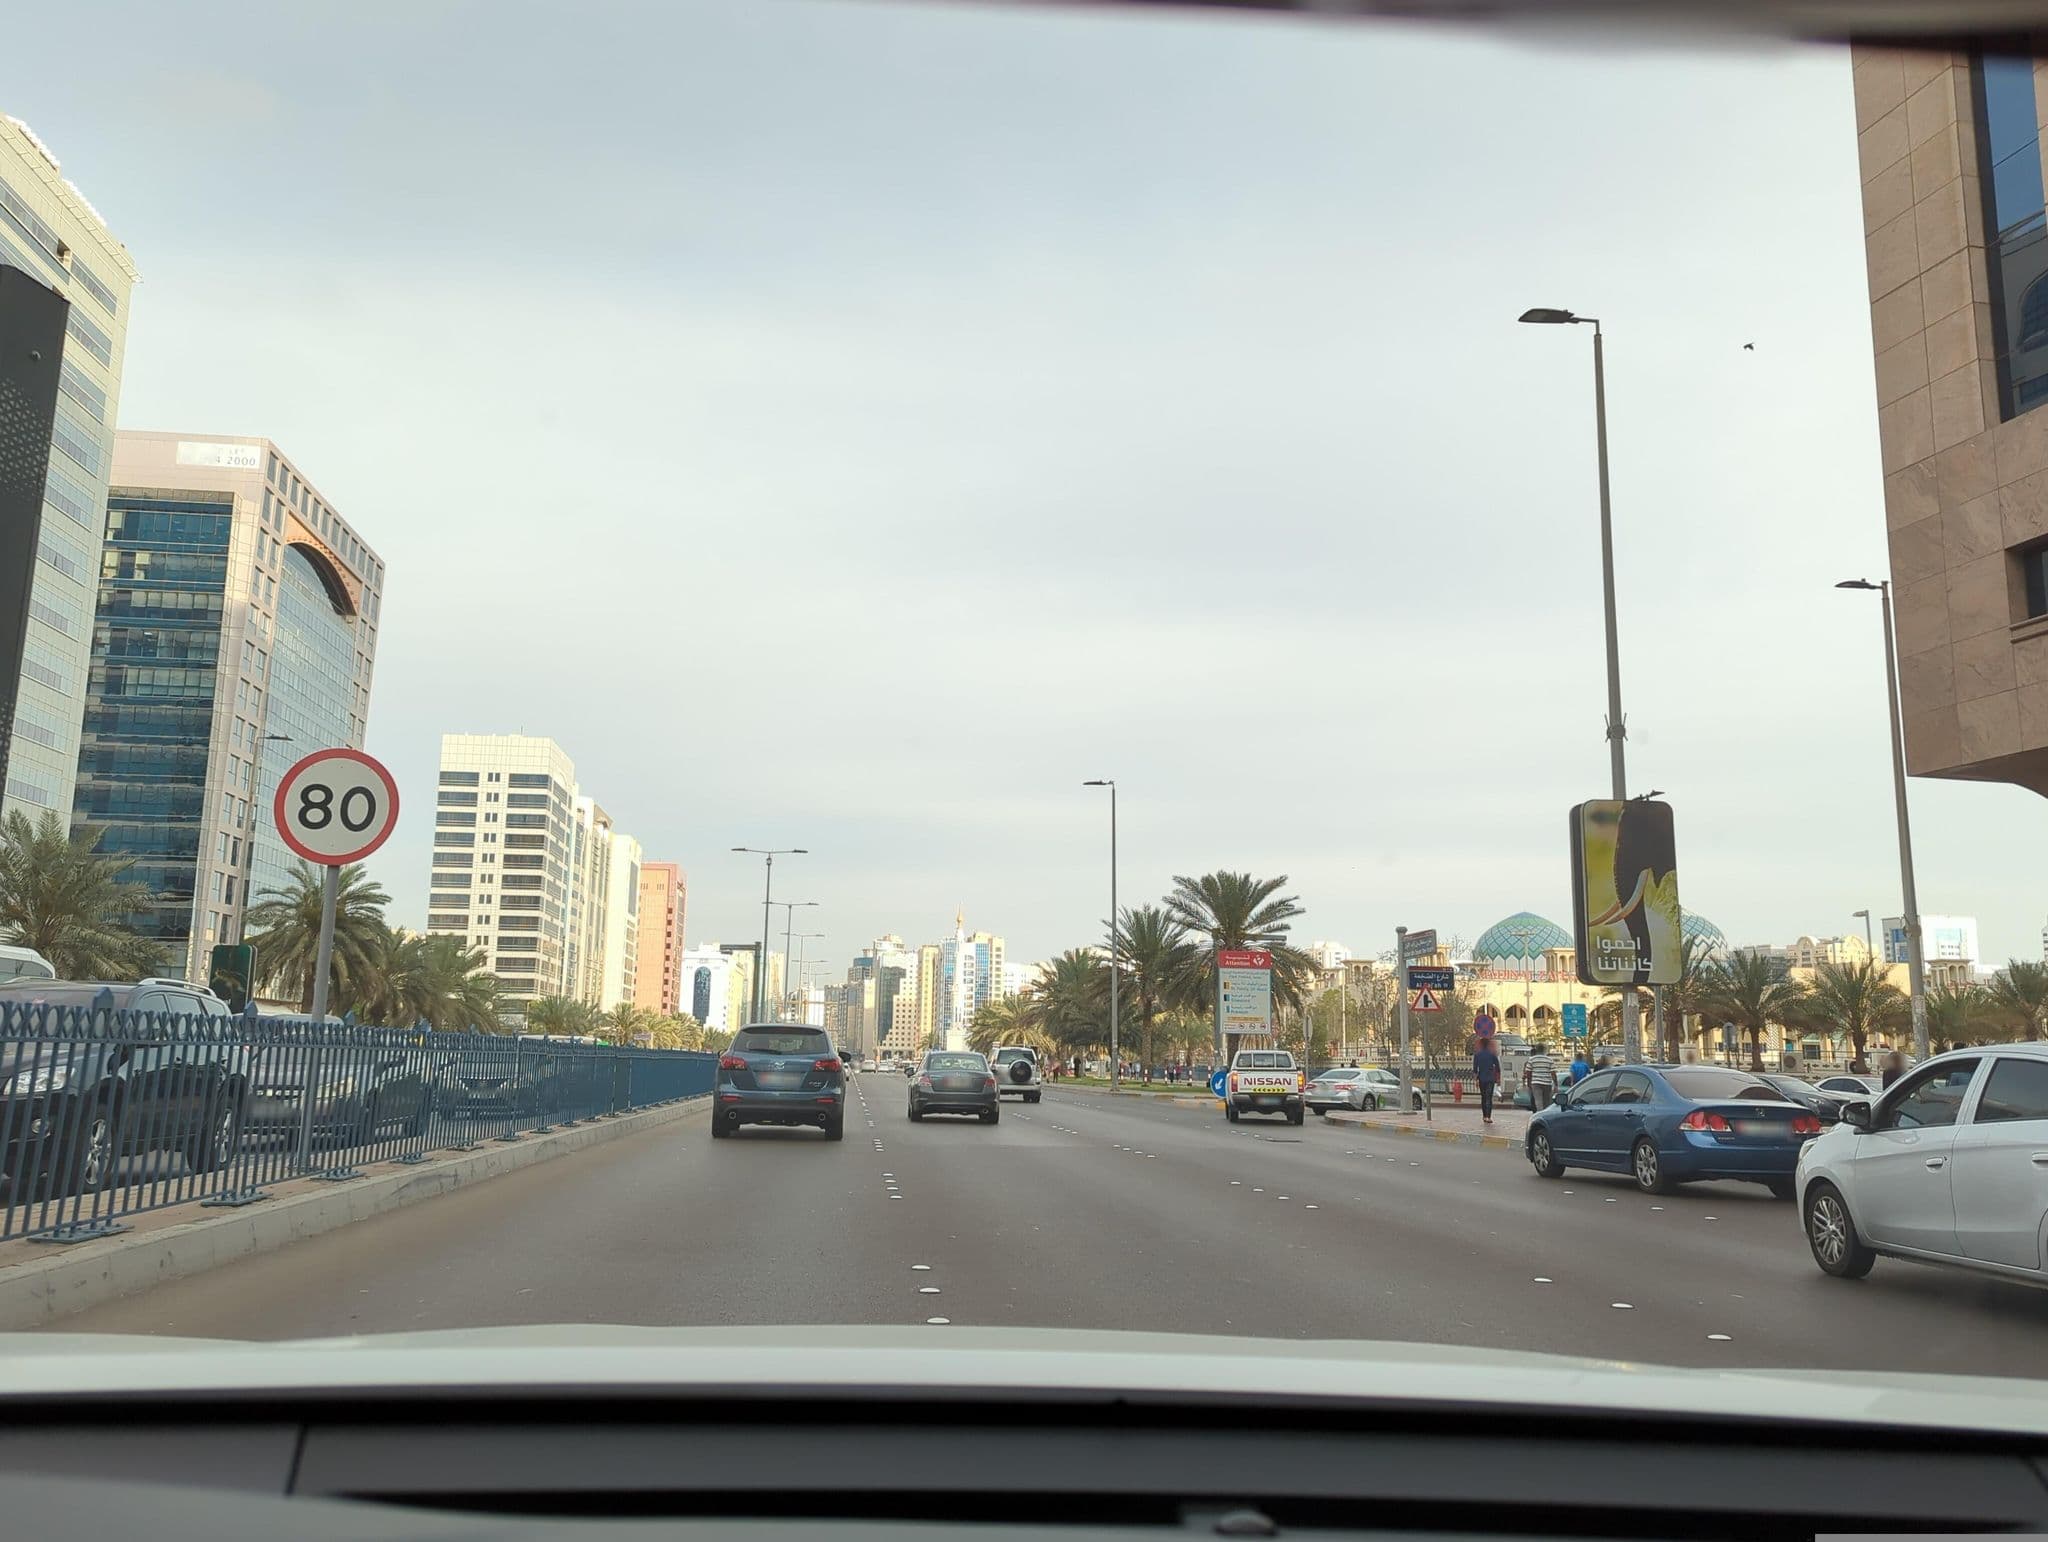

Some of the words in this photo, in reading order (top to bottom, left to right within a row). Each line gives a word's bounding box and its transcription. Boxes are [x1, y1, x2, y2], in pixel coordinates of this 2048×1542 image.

[297, 783, 377, 833] 80
[1596, 935, 1641, 953] احموا
[1597, 956, 1653, 972] كائناتنا
[1244, 1077, 1292, 1086] NISSAN
